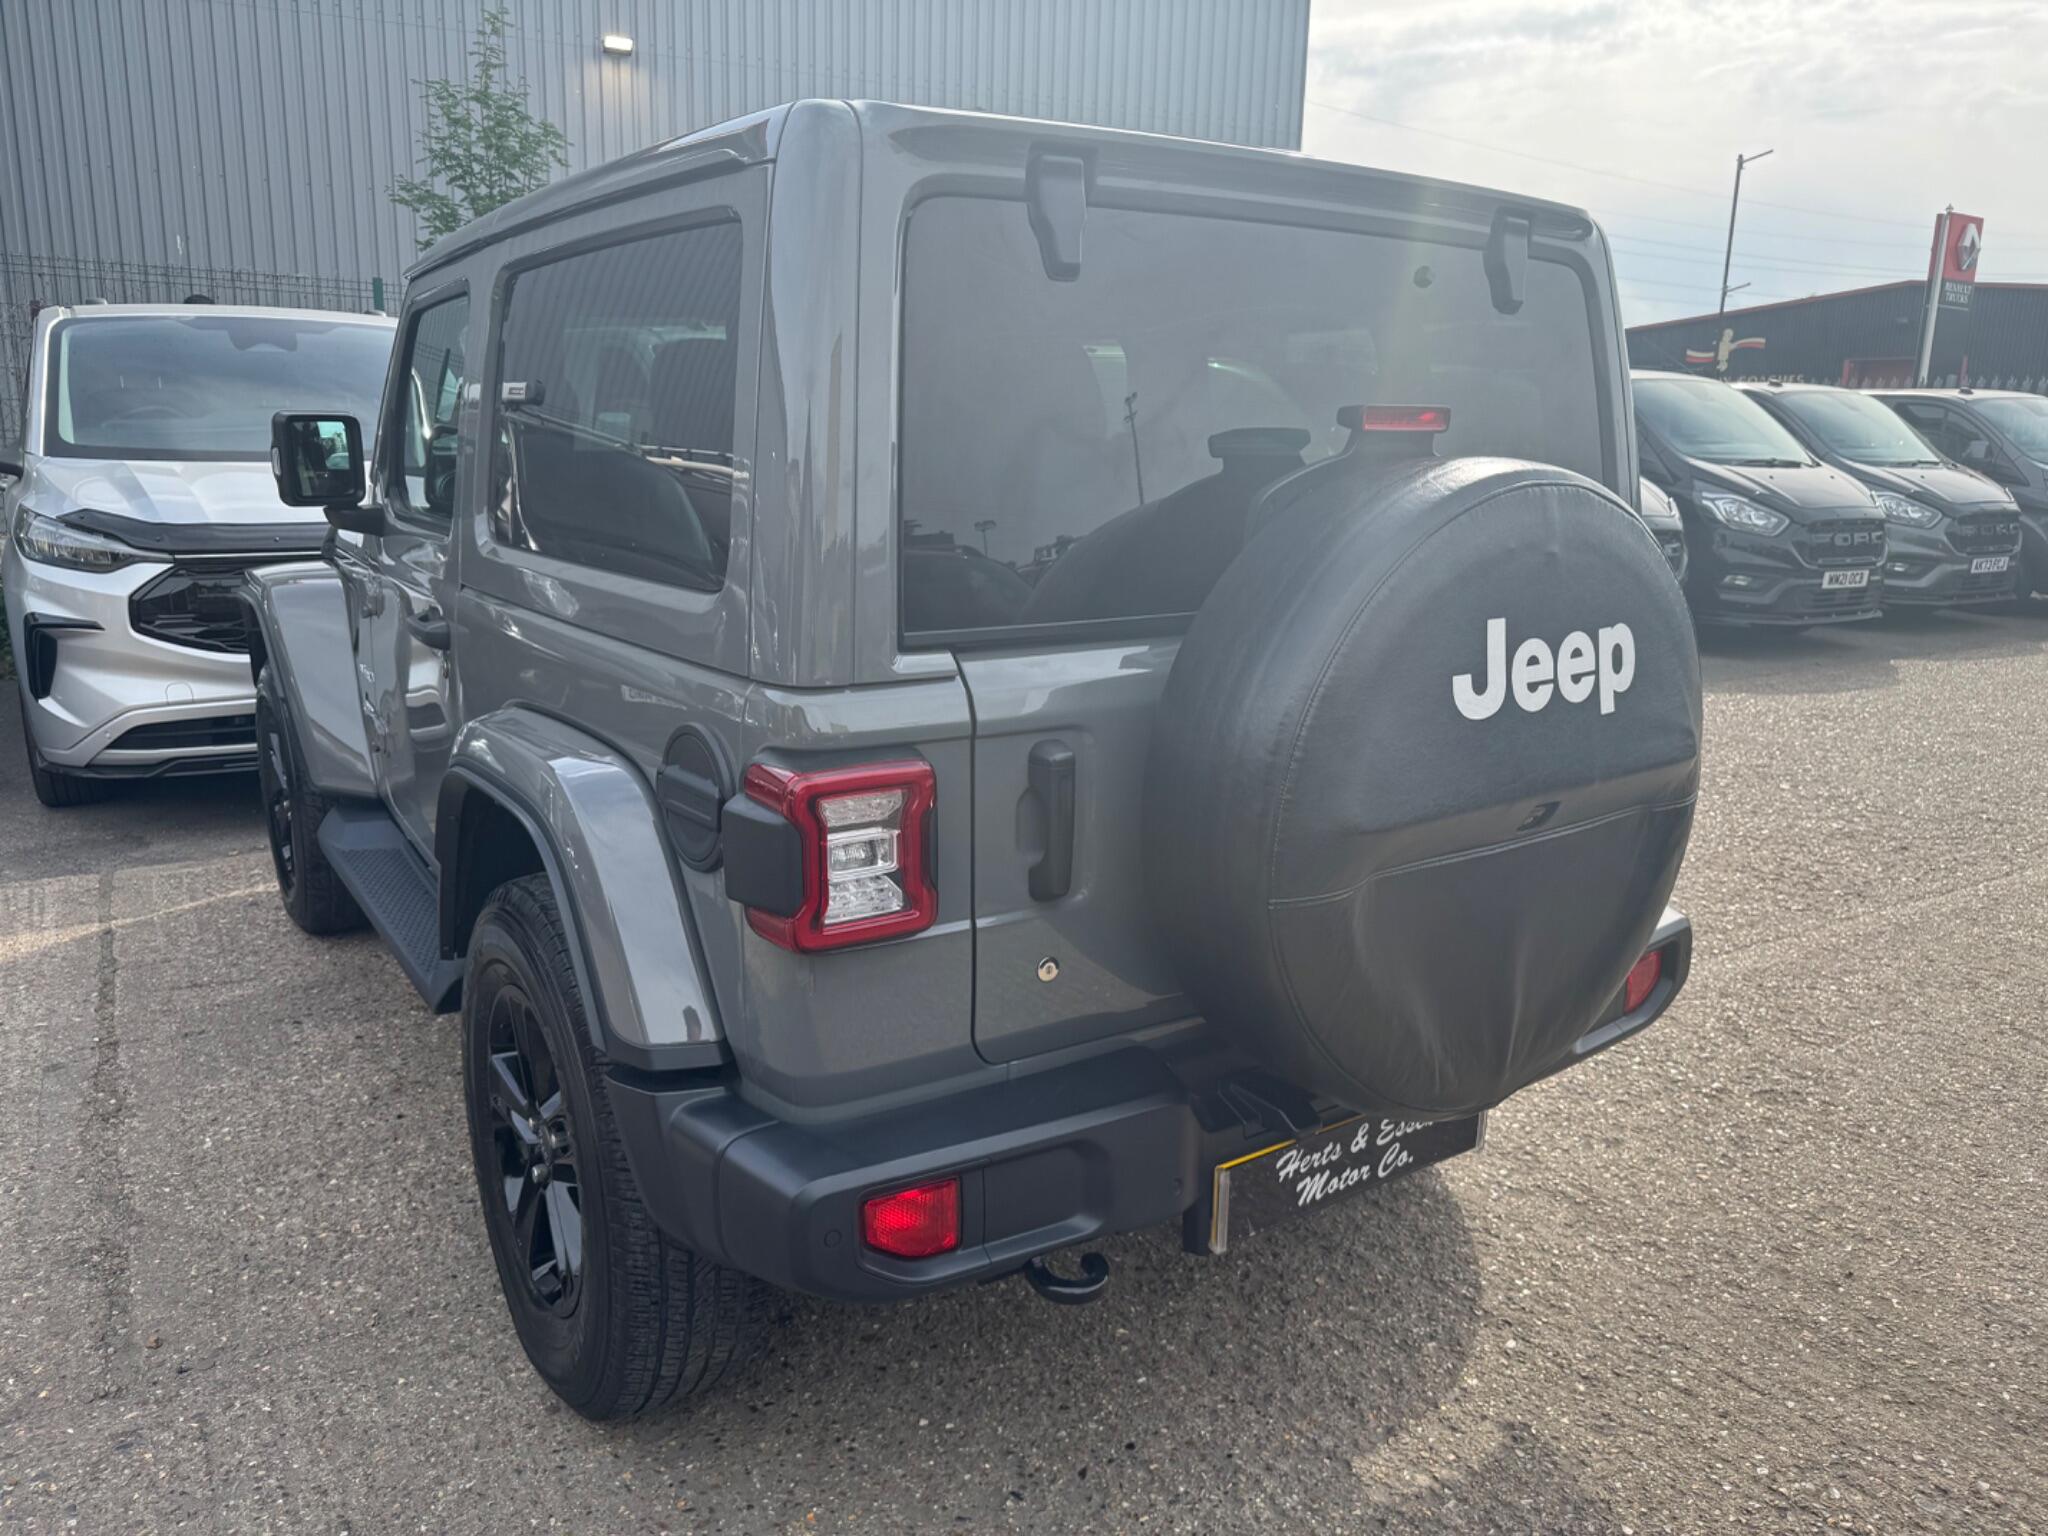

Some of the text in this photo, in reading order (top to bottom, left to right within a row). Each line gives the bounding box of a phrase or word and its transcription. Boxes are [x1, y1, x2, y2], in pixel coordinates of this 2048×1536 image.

[1452, 617, 1636, 720] Jeep
[1276, 1141, 1342, 1183] Herts
[1350, 1122, 1369, 1153] &
[1296, 1142, 1414, 1207] Motor Co.
